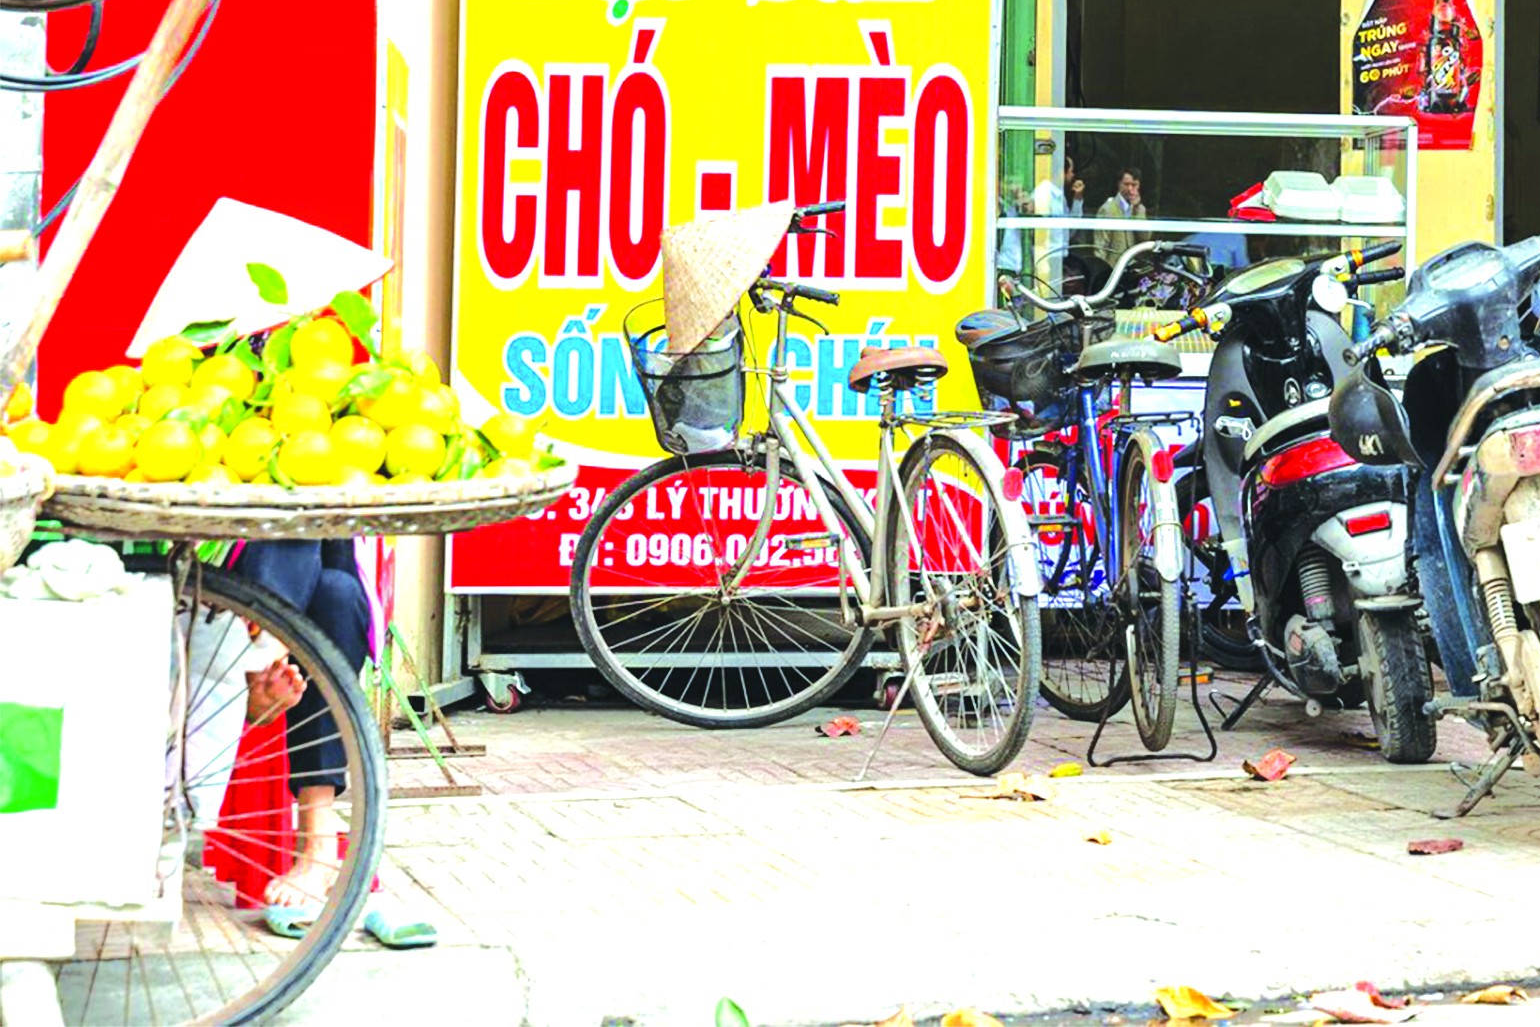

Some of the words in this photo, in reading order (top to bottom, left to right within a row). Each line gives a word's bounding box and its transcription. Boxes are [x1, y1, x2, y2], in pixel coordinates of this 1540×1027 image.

[481, 29, 666, 281] CHÓ
[768, 31, 969, 282] MÈO
[505, 308, 646, 416] SỐN
[647, 480, 688, 521] LÝ
